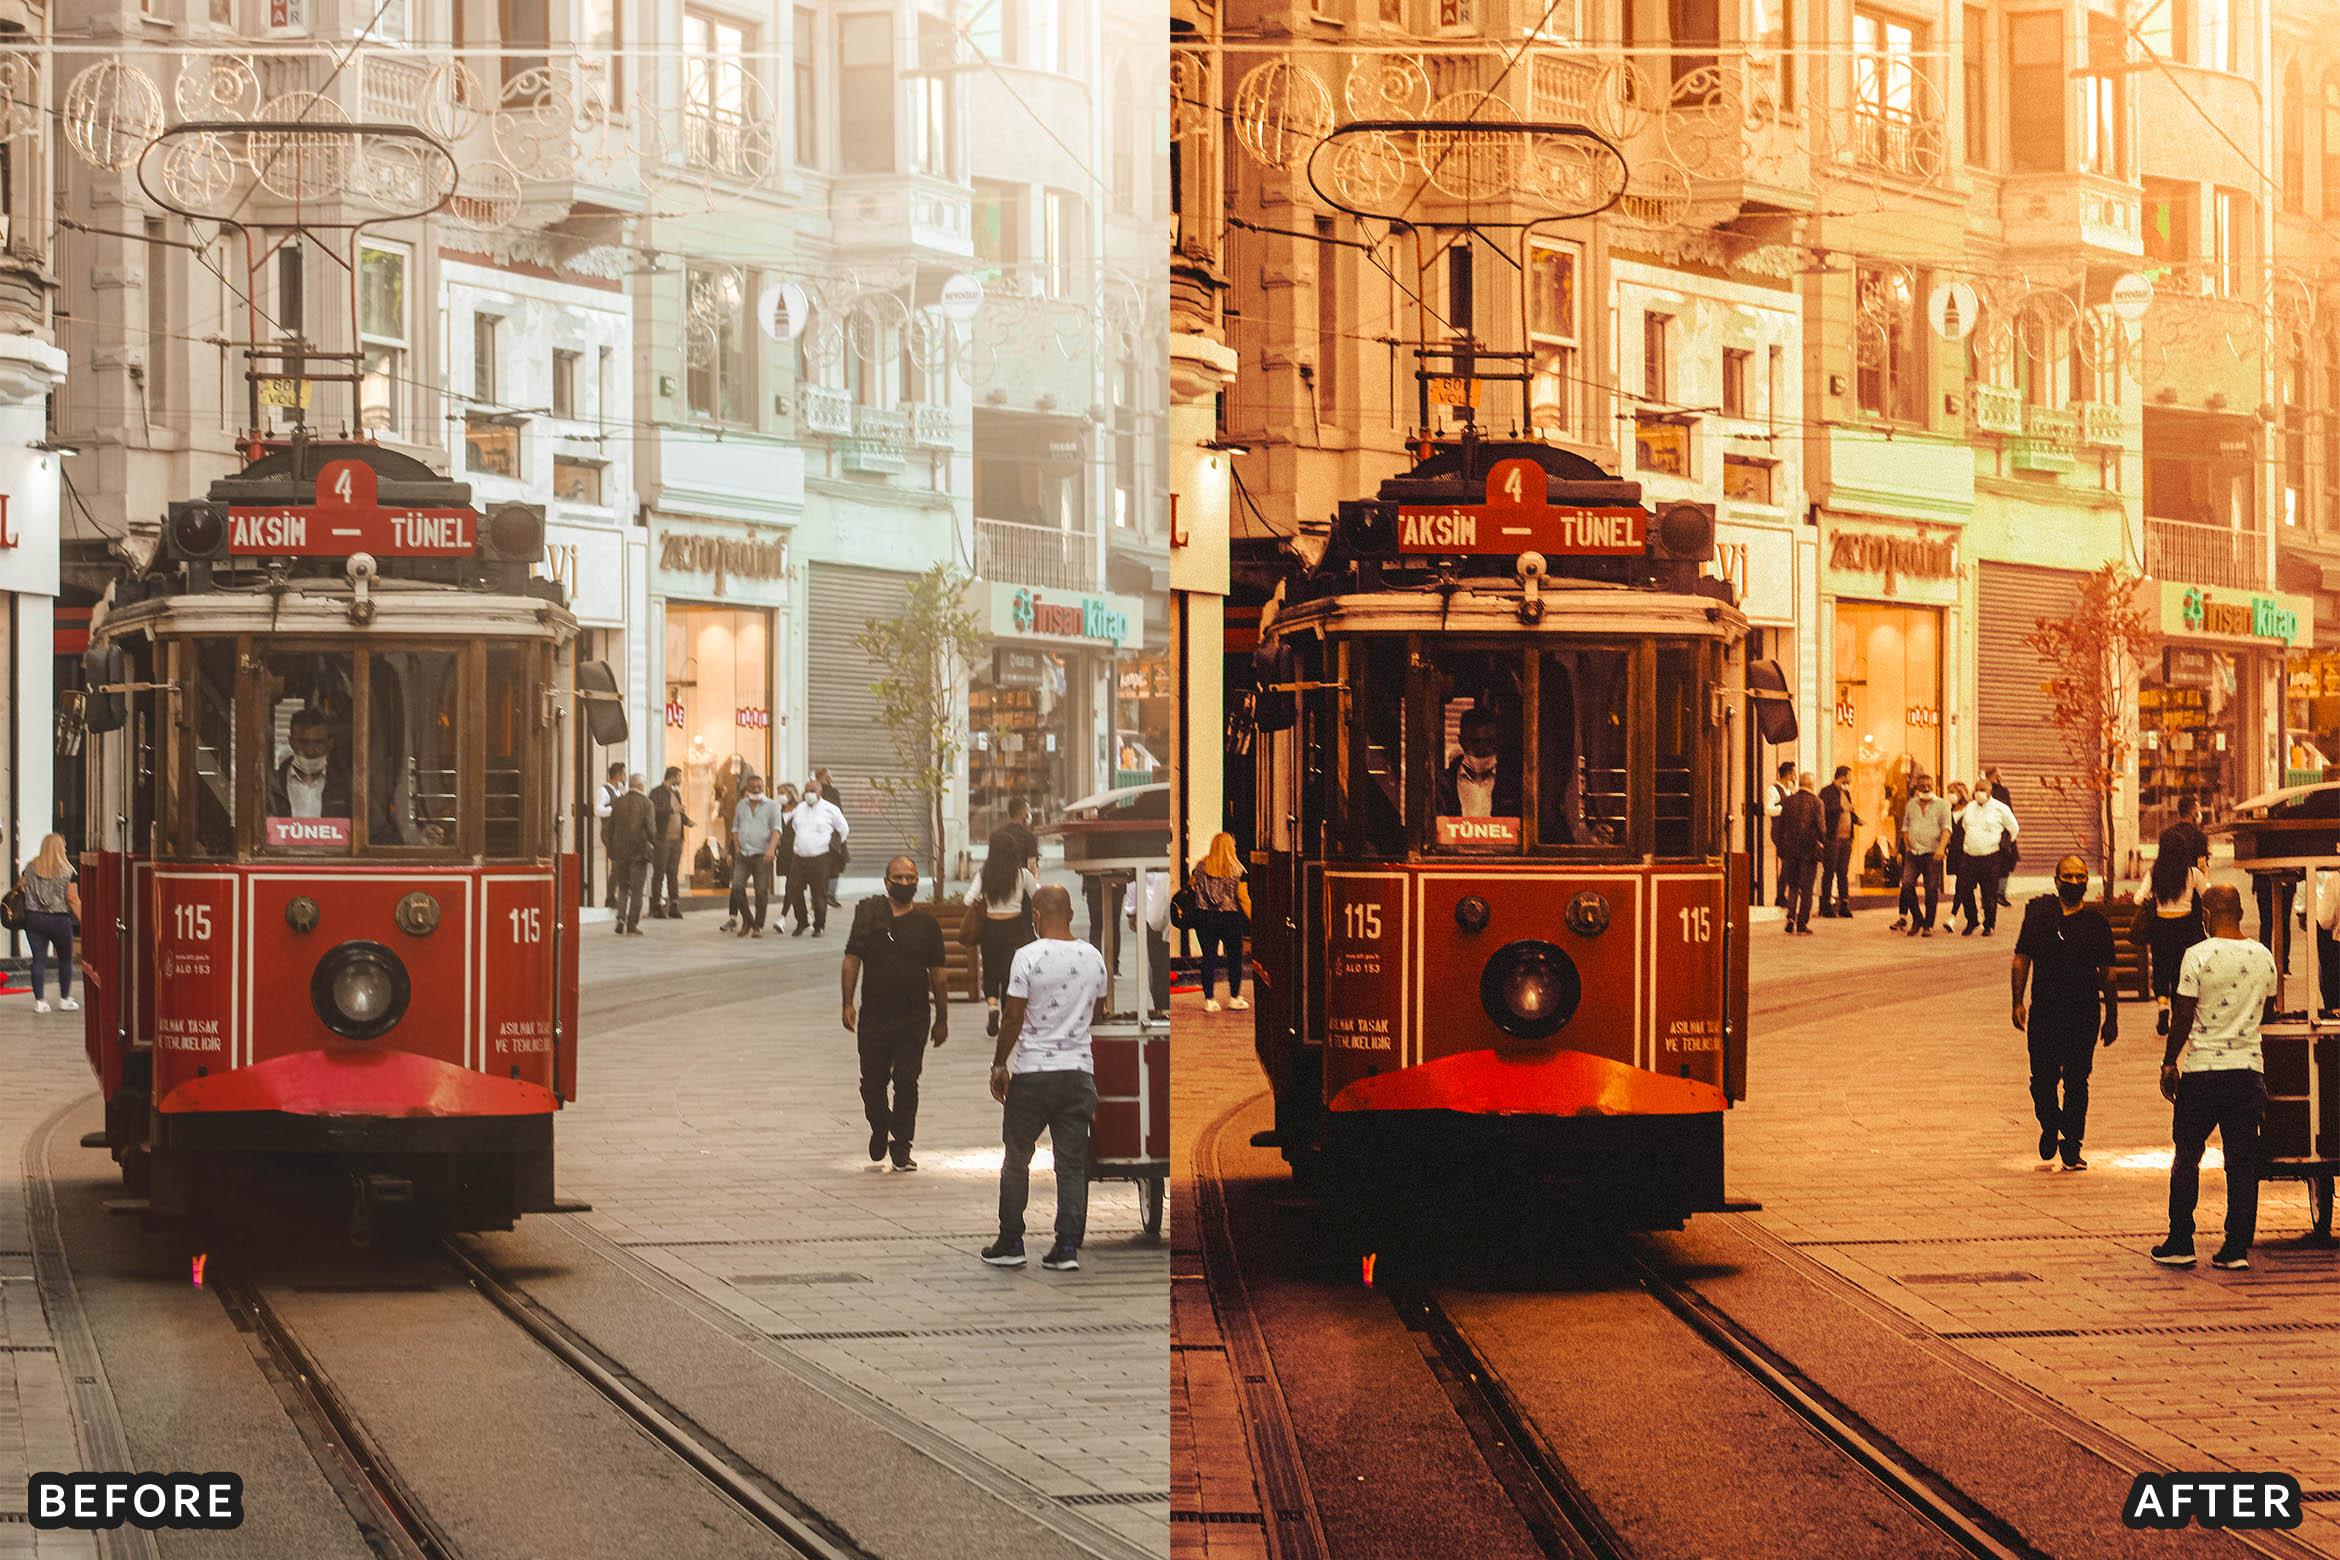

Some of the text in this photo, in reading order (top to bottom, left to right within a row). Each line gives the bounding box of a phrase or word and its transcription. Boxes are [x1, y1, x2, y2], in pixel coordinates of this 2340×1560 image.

[335, 468, 352, 504] 4
[1505, 467, 1522, 503] 4
[390, 511, 472, 548] TÜNEL
[1560, 510, 1642, 547] TÜNEL
[277, 822, 344, 840] TÜNEL
[1447, 821, 1514, 839] TÜNEL
[174, 904, 212, 940] 115
[508, 907, 541, 943] 115
[1344, 903, 1382, 939] 115
[1678, 906, 1711, 942] 115
[187, 1019, 219, 1035] YASAK
